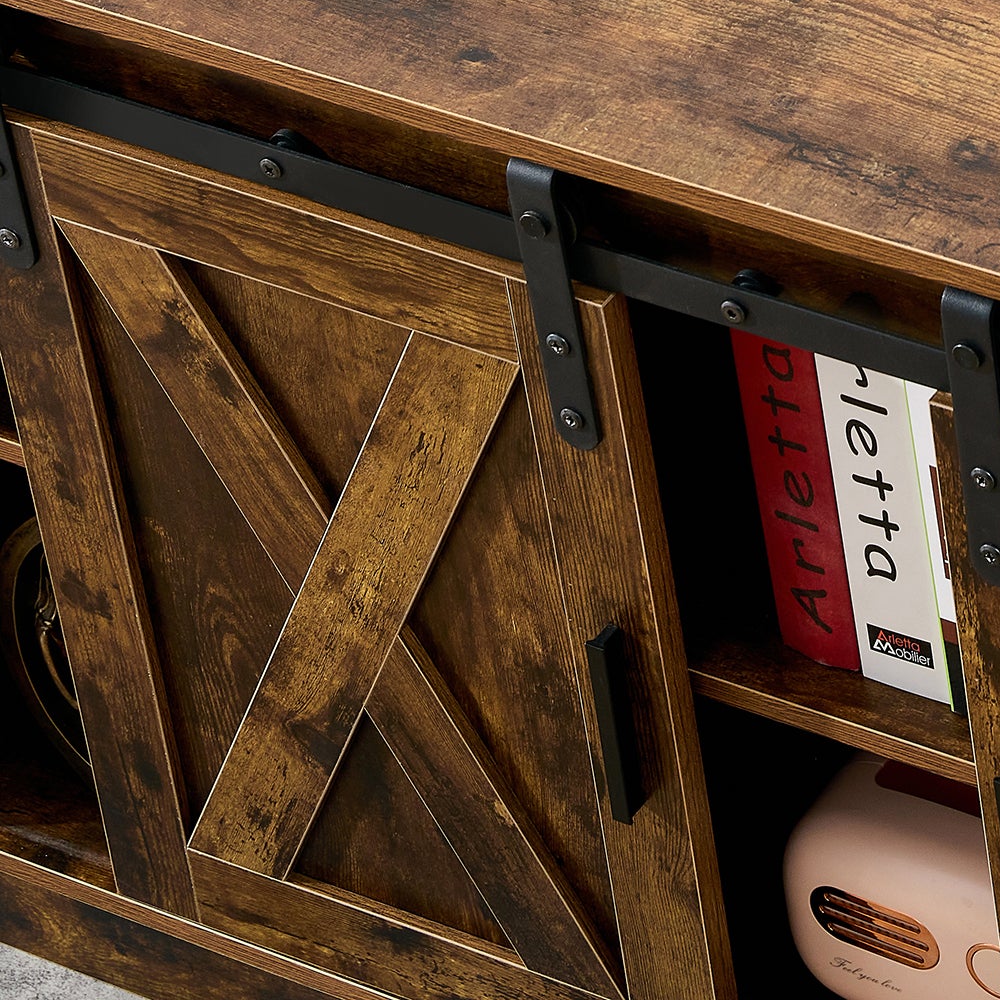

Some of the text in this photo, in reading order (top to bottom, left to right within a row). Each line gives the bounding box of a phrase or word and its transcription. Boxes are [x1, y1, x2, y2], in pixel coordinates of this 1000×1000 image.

[761, 344, 832, 634] Arletta
[873, 639, 930, 666] Mobilier
[877, 630, 920, 652] Arletta
[857, 973, 879, 983] you
